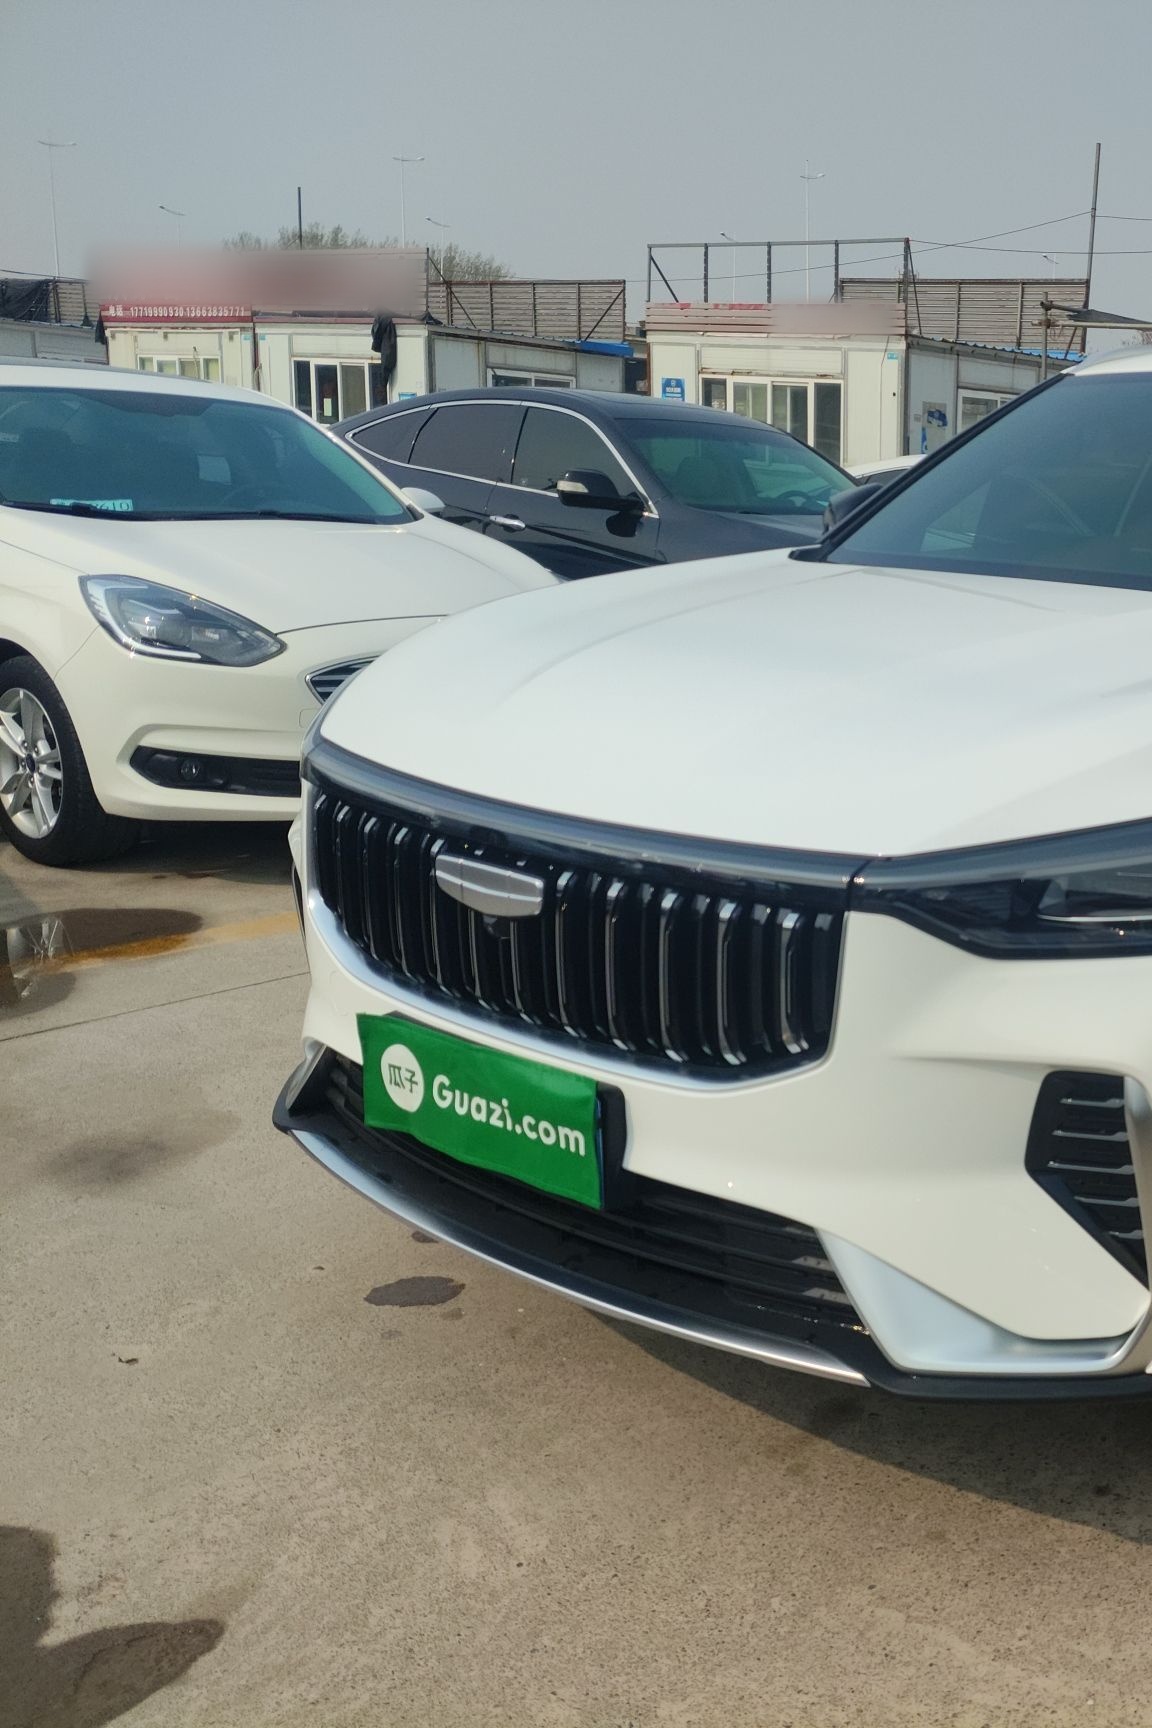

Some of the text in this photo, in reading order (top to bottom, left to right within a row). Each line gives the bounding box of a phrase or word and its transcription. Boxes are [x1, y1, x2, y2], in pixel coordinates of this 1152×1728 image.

[108, 305, 123, 317] 电话
[387, 1062, 418, 1094] 瓜子
[432, 1074, 586, 1157] Guazi.com
